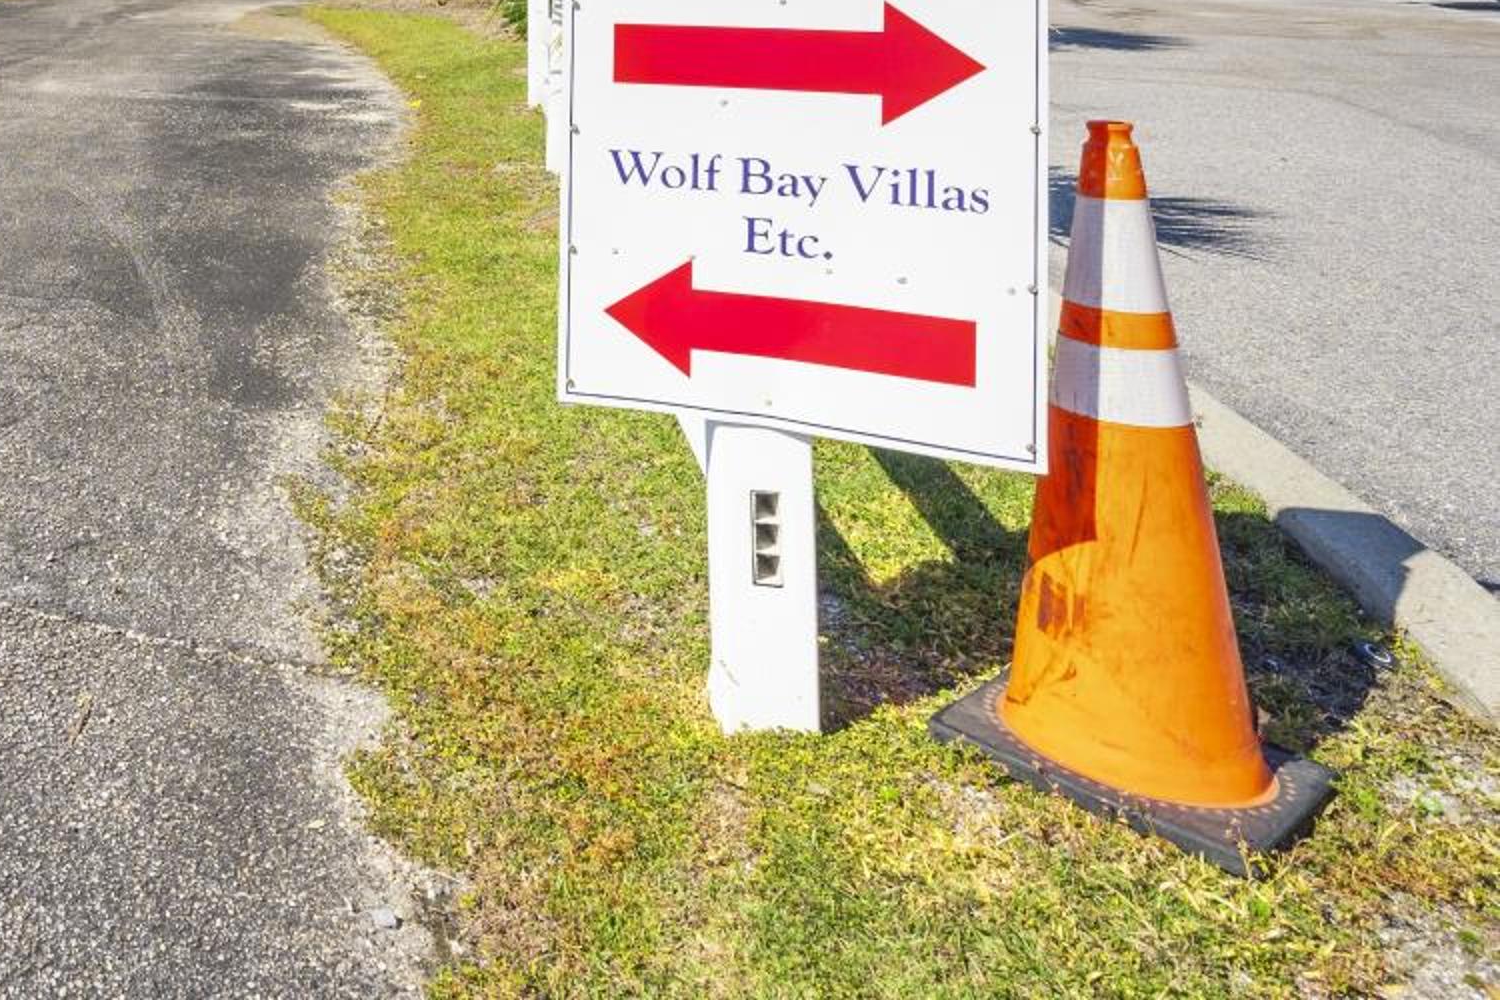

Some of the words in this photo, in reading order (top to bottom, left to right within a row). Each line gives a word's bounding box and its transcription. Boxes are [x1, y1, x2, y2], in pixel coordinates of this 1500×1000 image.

[608, 148, 723, 192] Wolf
[736, 157, 828, 208] Bay
[842, 163, 990, 215] Villas
[742, 215, 833, 261] Etc.
